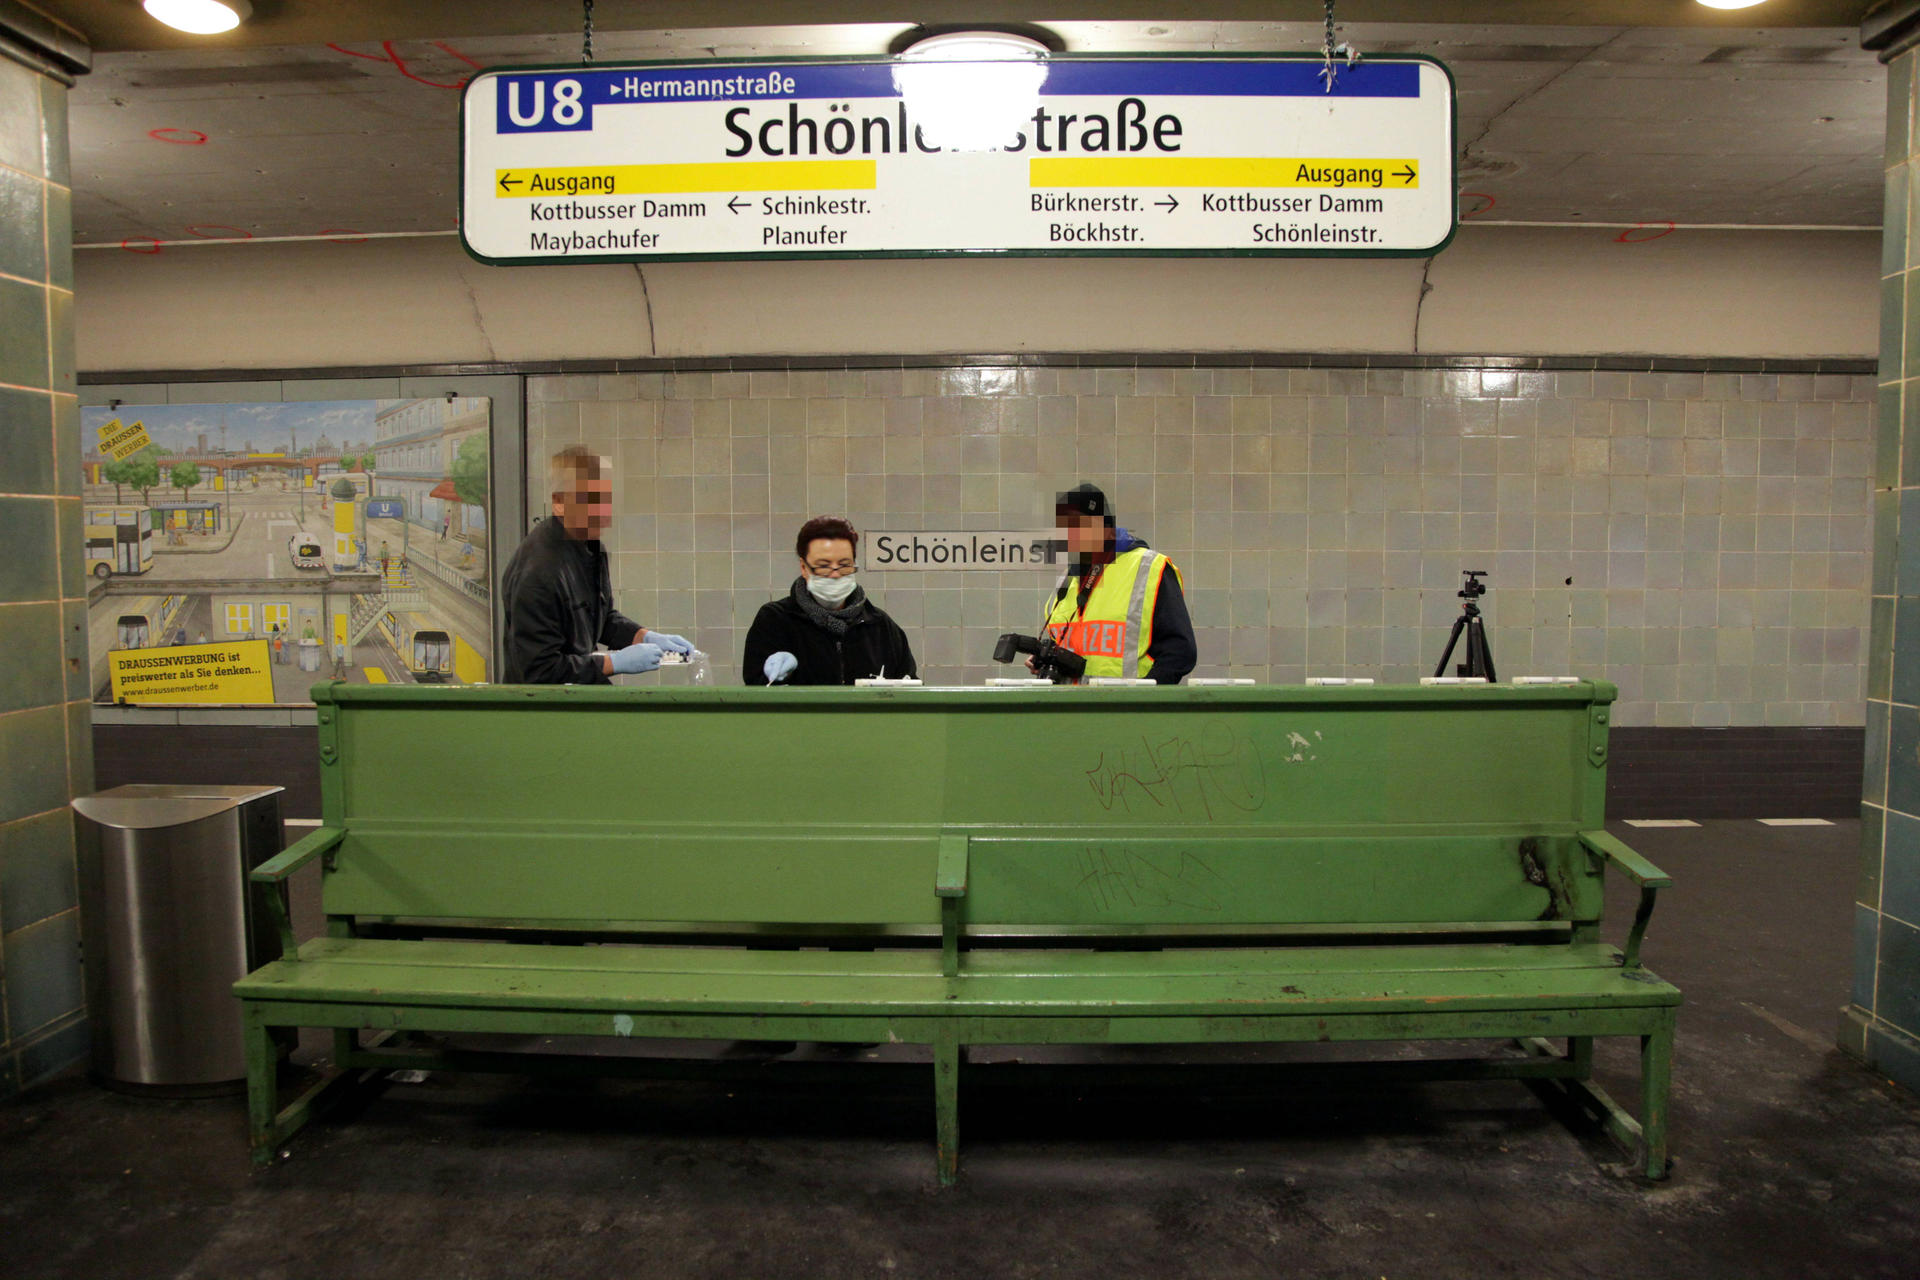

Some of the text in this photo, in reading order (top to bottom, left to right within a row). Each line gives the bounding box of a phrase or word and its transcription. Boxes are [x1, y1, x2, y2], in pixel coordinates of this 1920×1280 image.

[624, 71, 796, 98] Hermannstraße
[508, 79, 584, 127] U8
[725, 97, 1183, 157] Schönltraße
[530, 173, 616, 195] Ausgang
[1296, 164, 1384, 187] Ausgang
[530, 201, 707, 221] Kottbusser Damm
[762, 196, 872, 217] Schinkestr.
[1031, 192, 1145, 213] Bürknerstr.
[1202, 193, 1384, 213] Kottbusser Damm
[530, 231, 660, 254] Maybachufer
[762, 227, 848, 246] Planufer
[1050, 223, 1145, 242] Böckhstr.
[1252, 223, 1384, 243] Schönleinstr.
[100, 423, 143, 452] DRAUSSEN
[118, 652, 241, 670] DRAUSSENWERBUNG ist
[120, 665, 261, 685] preiswerter als Sie denken...
[122, 682, 219, 697] www.draussenwerber.de
